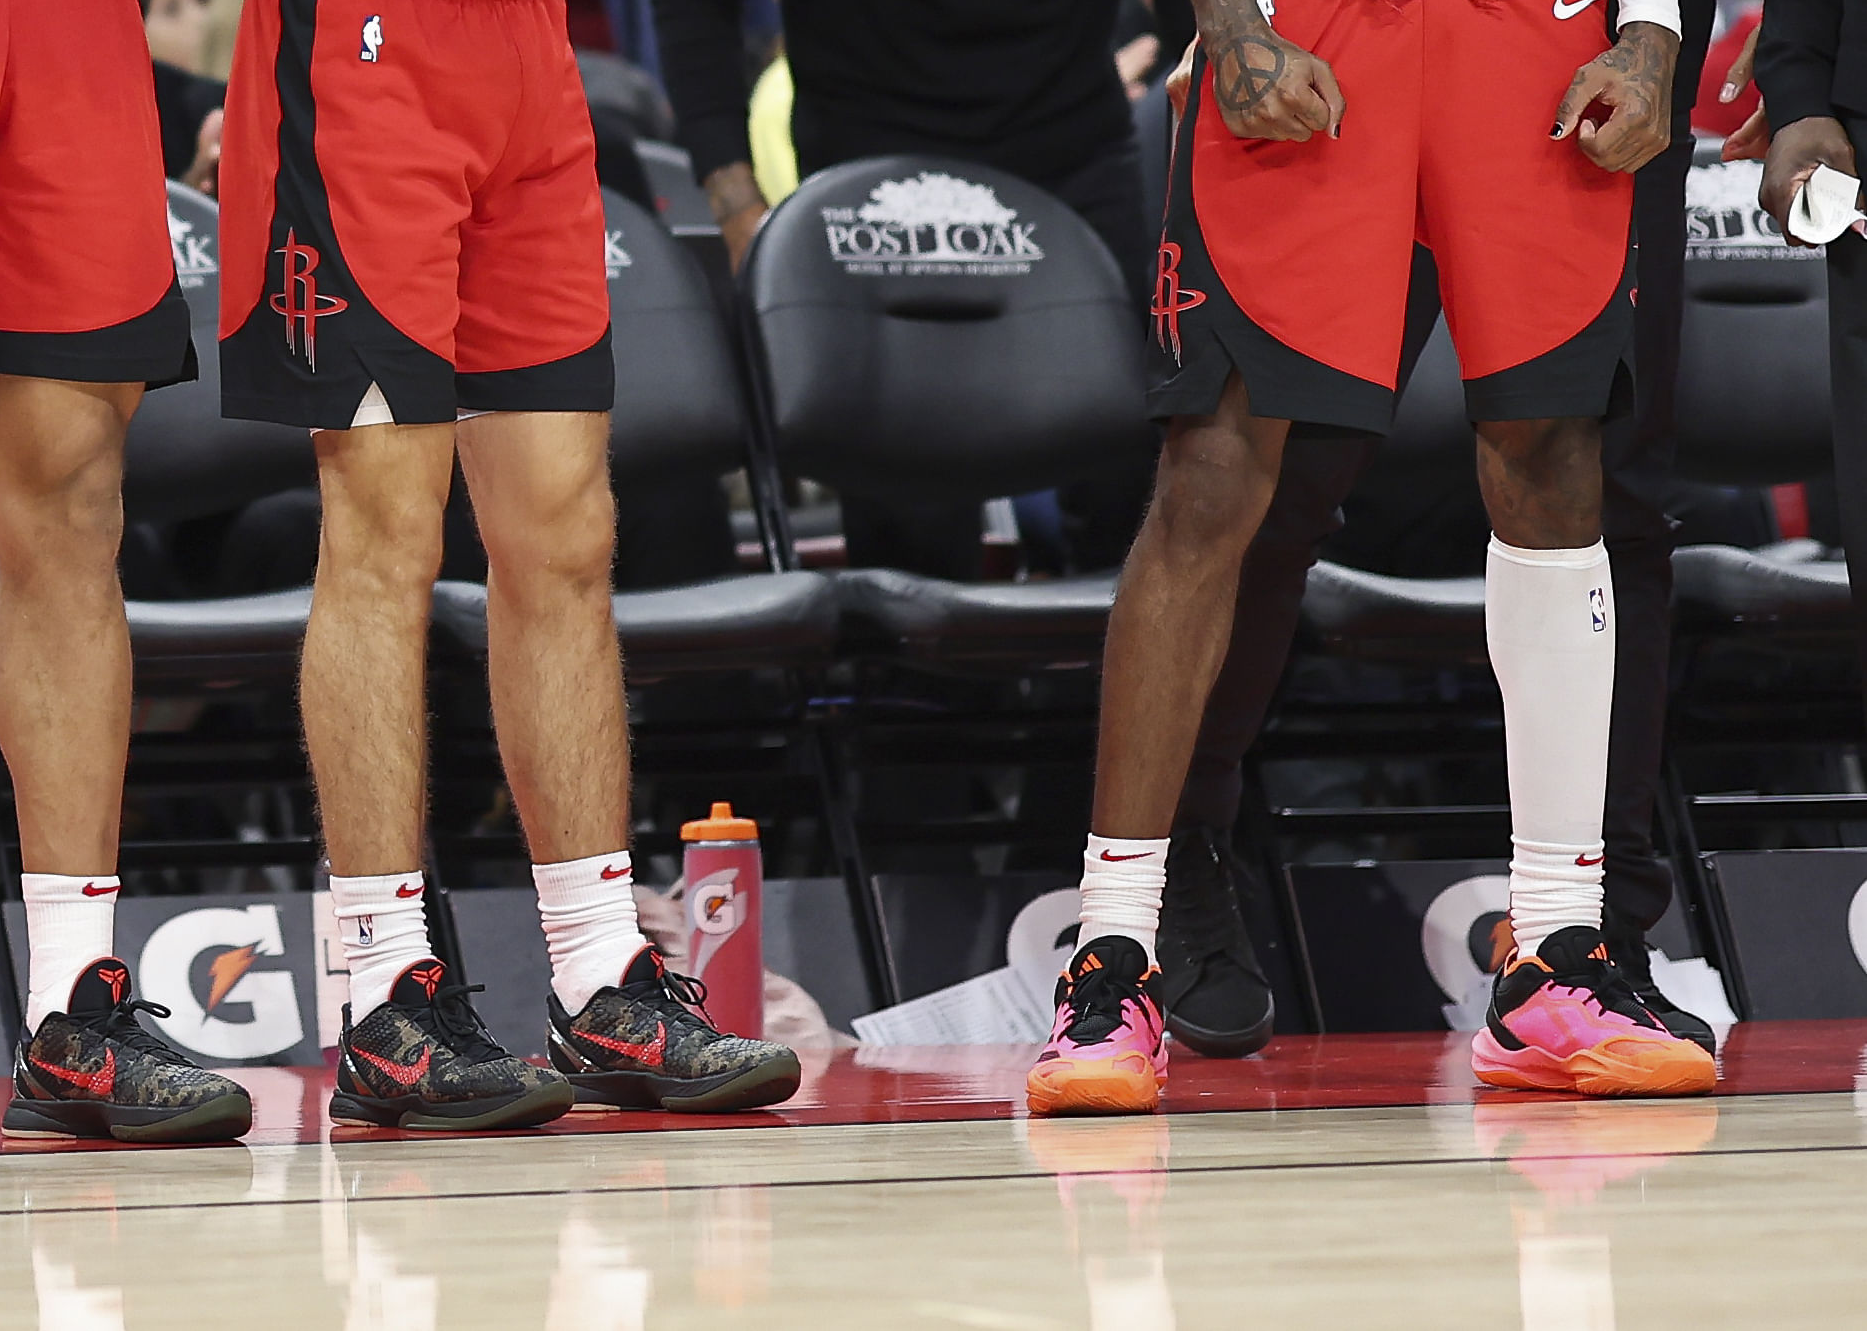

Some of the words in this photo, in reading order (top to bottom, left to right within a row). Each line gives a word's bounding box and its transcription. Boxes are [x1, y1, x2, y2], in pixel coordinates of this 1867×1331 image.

[826, 223, 928, 255] POST
[952, 222, 1040, 256] OAK
[139, 904, 305, 1060] G
